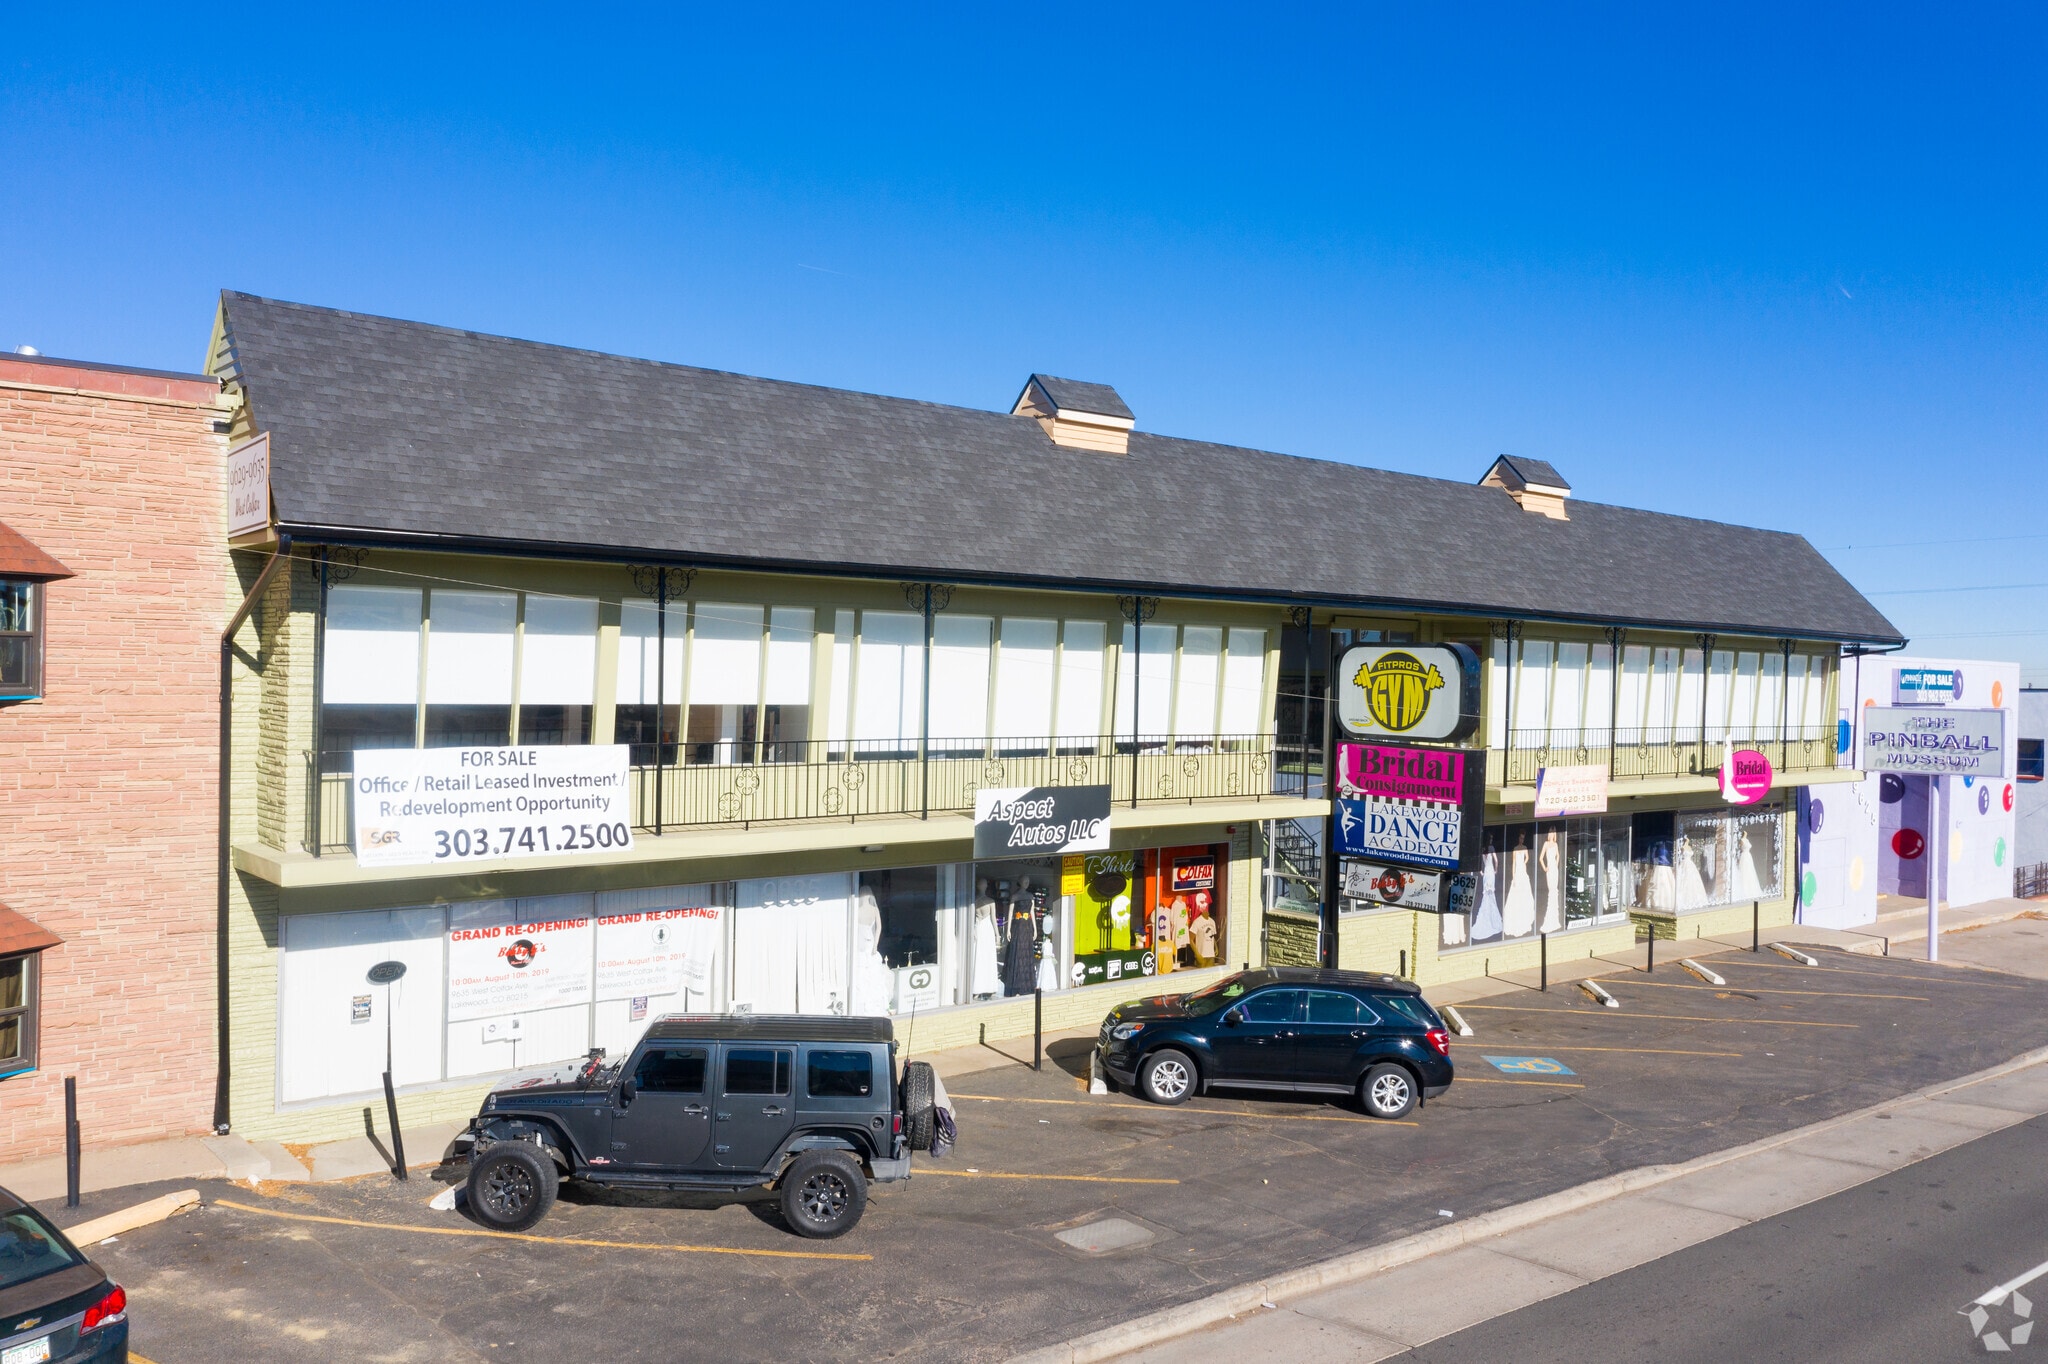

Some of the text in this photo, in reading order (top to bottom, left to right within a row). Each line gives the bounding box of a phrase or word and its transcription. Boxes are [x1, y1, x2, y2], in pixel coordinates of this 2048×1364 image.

[230, 452, 265, 493] 9629-9635
[1377, 660, 1421, 671] FITPROS
[1923, 674, 1936, 685] FOR
[1937, 674, 1953, 686] SALE
[1371, 674, 1425, 728] GYM
[1912, 716, 1956, 729] THE
[1869, 732, 1999, 751] PINBALL
[461, 750, 537, 767] FOR SALE
[1358, 747, 1457, 782] Bridal
[1736, 760, 1766, 775] Bridal
[1886, 753, 1980, 768] MUSEUM
[359, 776, 409, 795] Office
[424, 774, 471, 791] Retail
[475, 772, 530, 790] Leased
[532, 772, 618, 789] Investment
[1356, 775, 1457, 799] Consignment
[380, 793, 611, 818] Redevelopment Opportunity
[986, 796, 1055, 825] Aspect
[1371, 803, 1459, 823] LAKEWOOD
[370, 829, 402, 845] SGR
[1007, 818, 1102, 848] Autos LLC
[1369, 814, 1458, 845] DANCE
[434, 821, 630, 859] 303.741.2500
[1368, 836, 1457, 857] ACADEMY
[1085, 855, 1137, 874] T-Shirts
[1345, 846, 1449, 867] www.lakewooddance.com
[1177, 864, 1213, 882] COLFAX
[1453, 875, 1476, 889] 9629
[1452, 893, 1473, 907] 9635
[598, 907, 719, 926] GRAND RE-OPENING!
[451, 917, 589, 942] GRAND RE-OPENING!
[627, 957, 650, 965] August
[669, 952, 687, 961] 2019
[372, 966, 403, 977] OPEN
[451, 977, 482, 988] 10:00AM
[485, 974, 510, 983] August
[532, 968, 550, 977] 2019
[616, 969, 632, 977] West
[633, 967, 653, 976] Colfax
[472, 987, 489, 995] West
[490, 984, 513, 993] Colfax
[491, 994, 505, 1003] CO
[506, 992, 529, 1002] 80215
